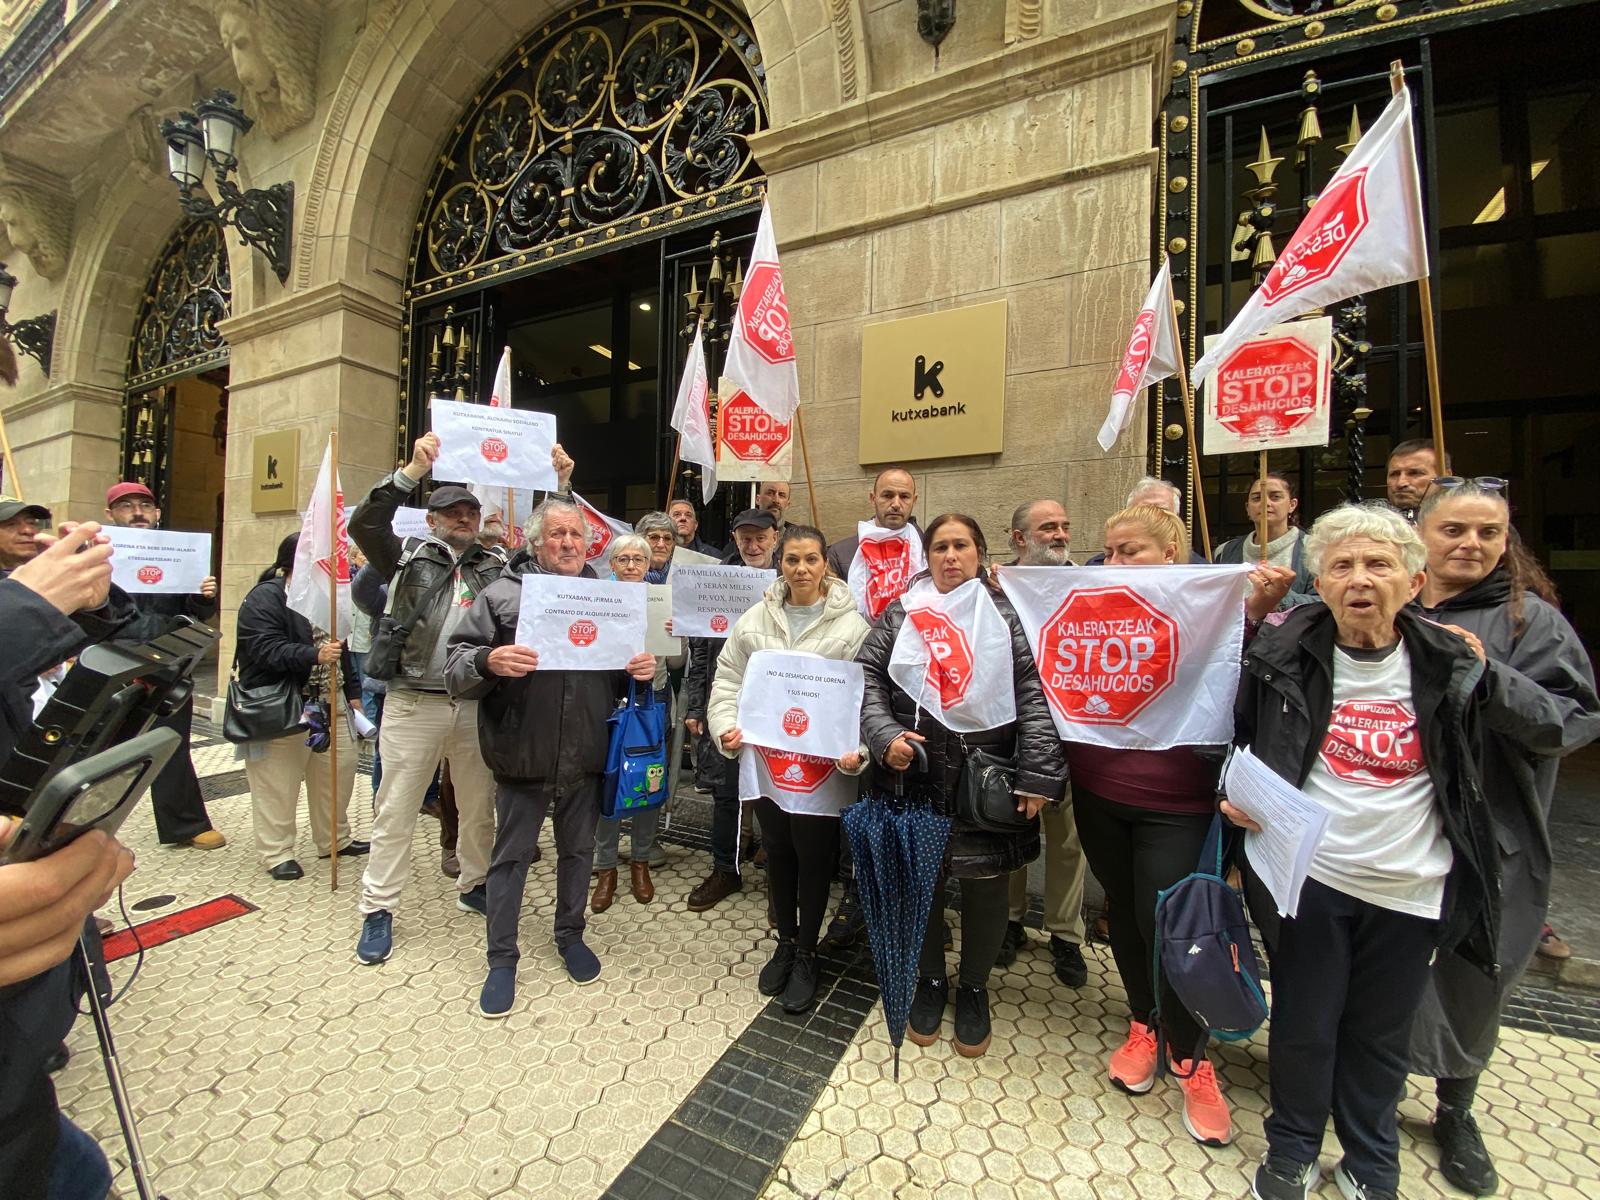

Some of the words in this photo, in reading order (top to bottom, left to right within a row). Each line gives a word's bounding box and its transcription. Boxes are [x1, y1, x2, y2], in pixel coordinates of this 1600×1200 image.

[1223, 361, 1312, 382] KALERATZEAK
[1222, 372, 1313, 404] STOP
[1222, 394, 1312, 415] DESAHUCIOS
[728, 406, 768, 415] KALERAT
[891, 401, 966, 423] kutxabank
[727, 432, 783, 441] DESAHUCIOS
[483, 442, 506, 452] STOP
[140, 569, 161, 577] STOP
[687, 569, 721, 578] FAMILIAS
[557, 594, 592, 602] KUTXABANK,
[544, 608, 575, 616] CONTRATO
[697, 606, 747, 614] RESPONSABLE
[572, 625, 595, 634] STOP
[1058, 618, 1157, 636] KALERATZEAK
[1055, 637, 1156, 674] STOP
[785, 672, 814, 681] DESAHUCIO
[823, 676, 846, 685] LORENA
[1051, 673, 1154, 693] DESAHUCIOS
[1353, 704, 1396, 715] GIPUZKOA
[785, 713, 807, 724] STOP
